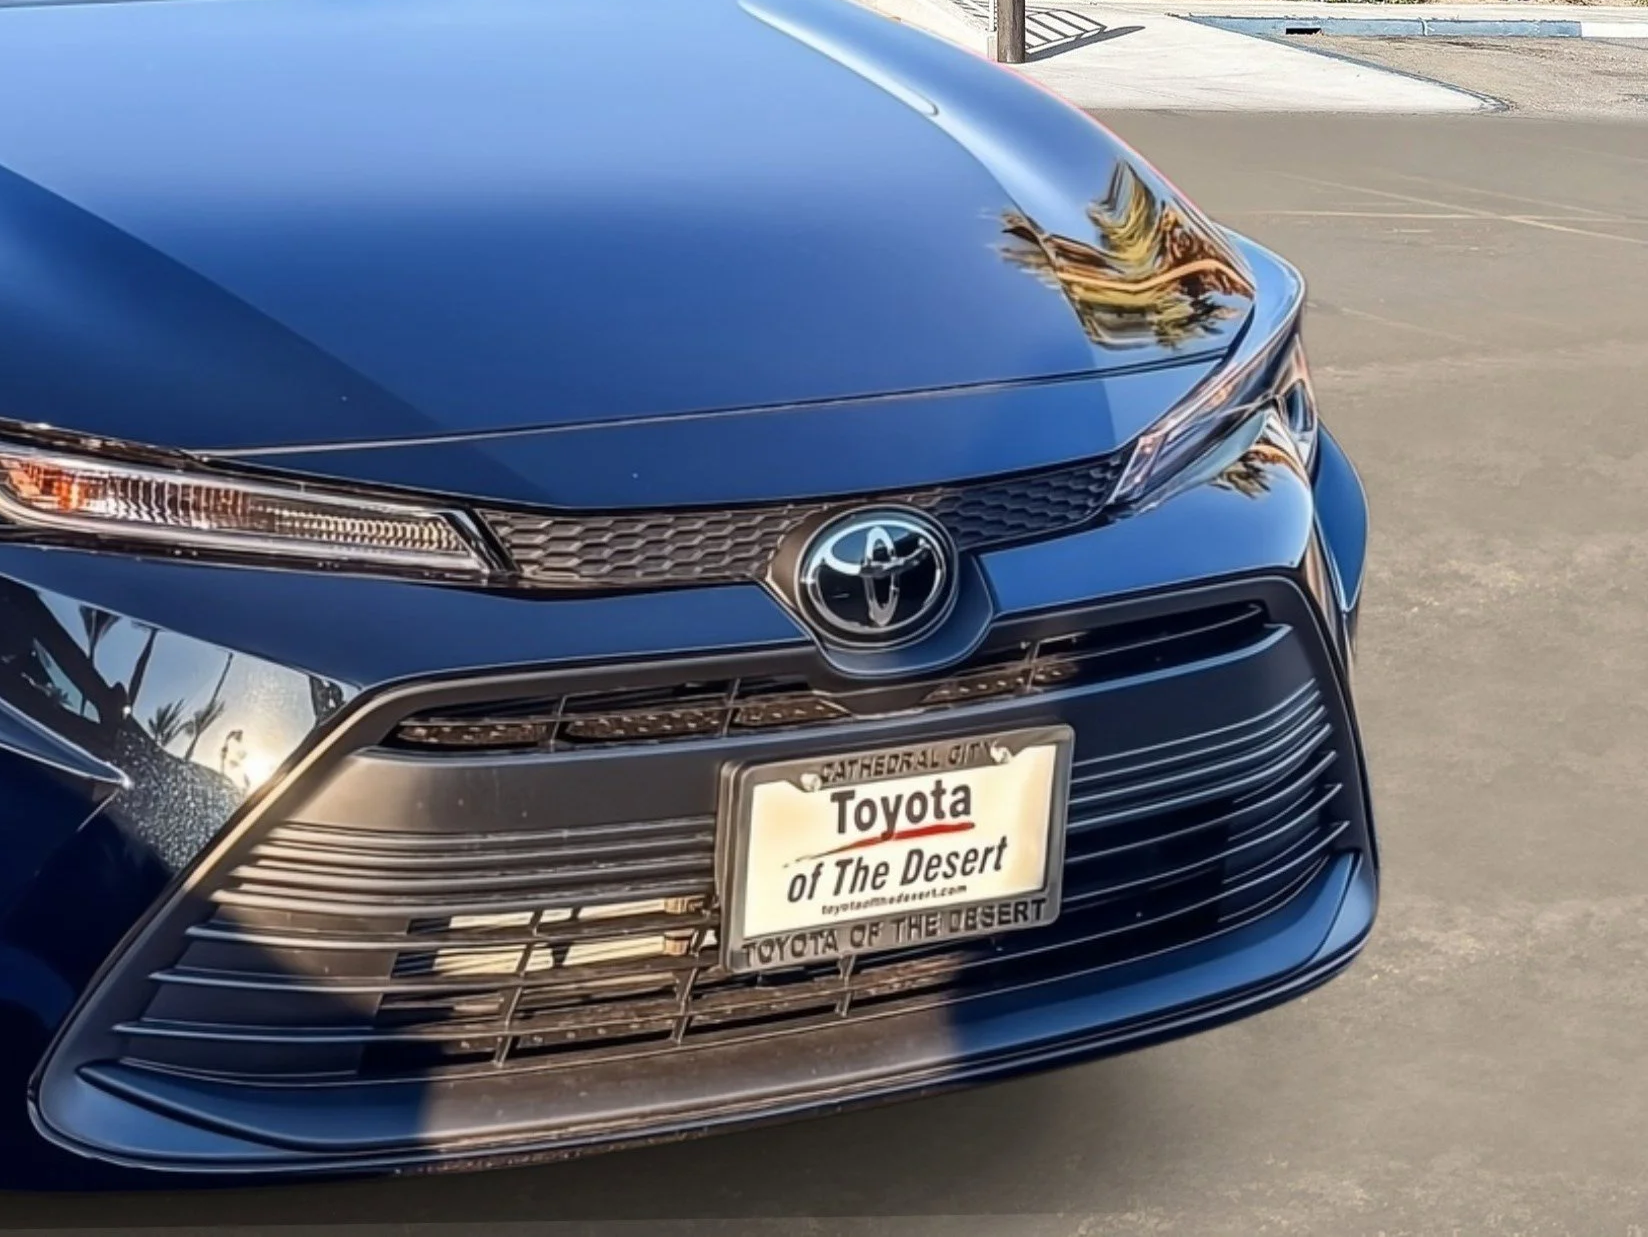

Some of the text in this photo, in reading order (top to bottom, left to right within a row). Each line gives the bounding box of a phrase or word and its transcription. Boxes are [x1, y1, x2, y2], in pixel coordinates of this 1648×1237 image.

[820, 748, 940, 783] CATHEDRAL
[830, 779, 973, 840] Toyota
[787, 835, 1009, 904] of The Desert
[821, 884, 968, 916] toyotaofthedesert.com
[741, 897, 1048, 968] TOYOTA OF THE DESERT
